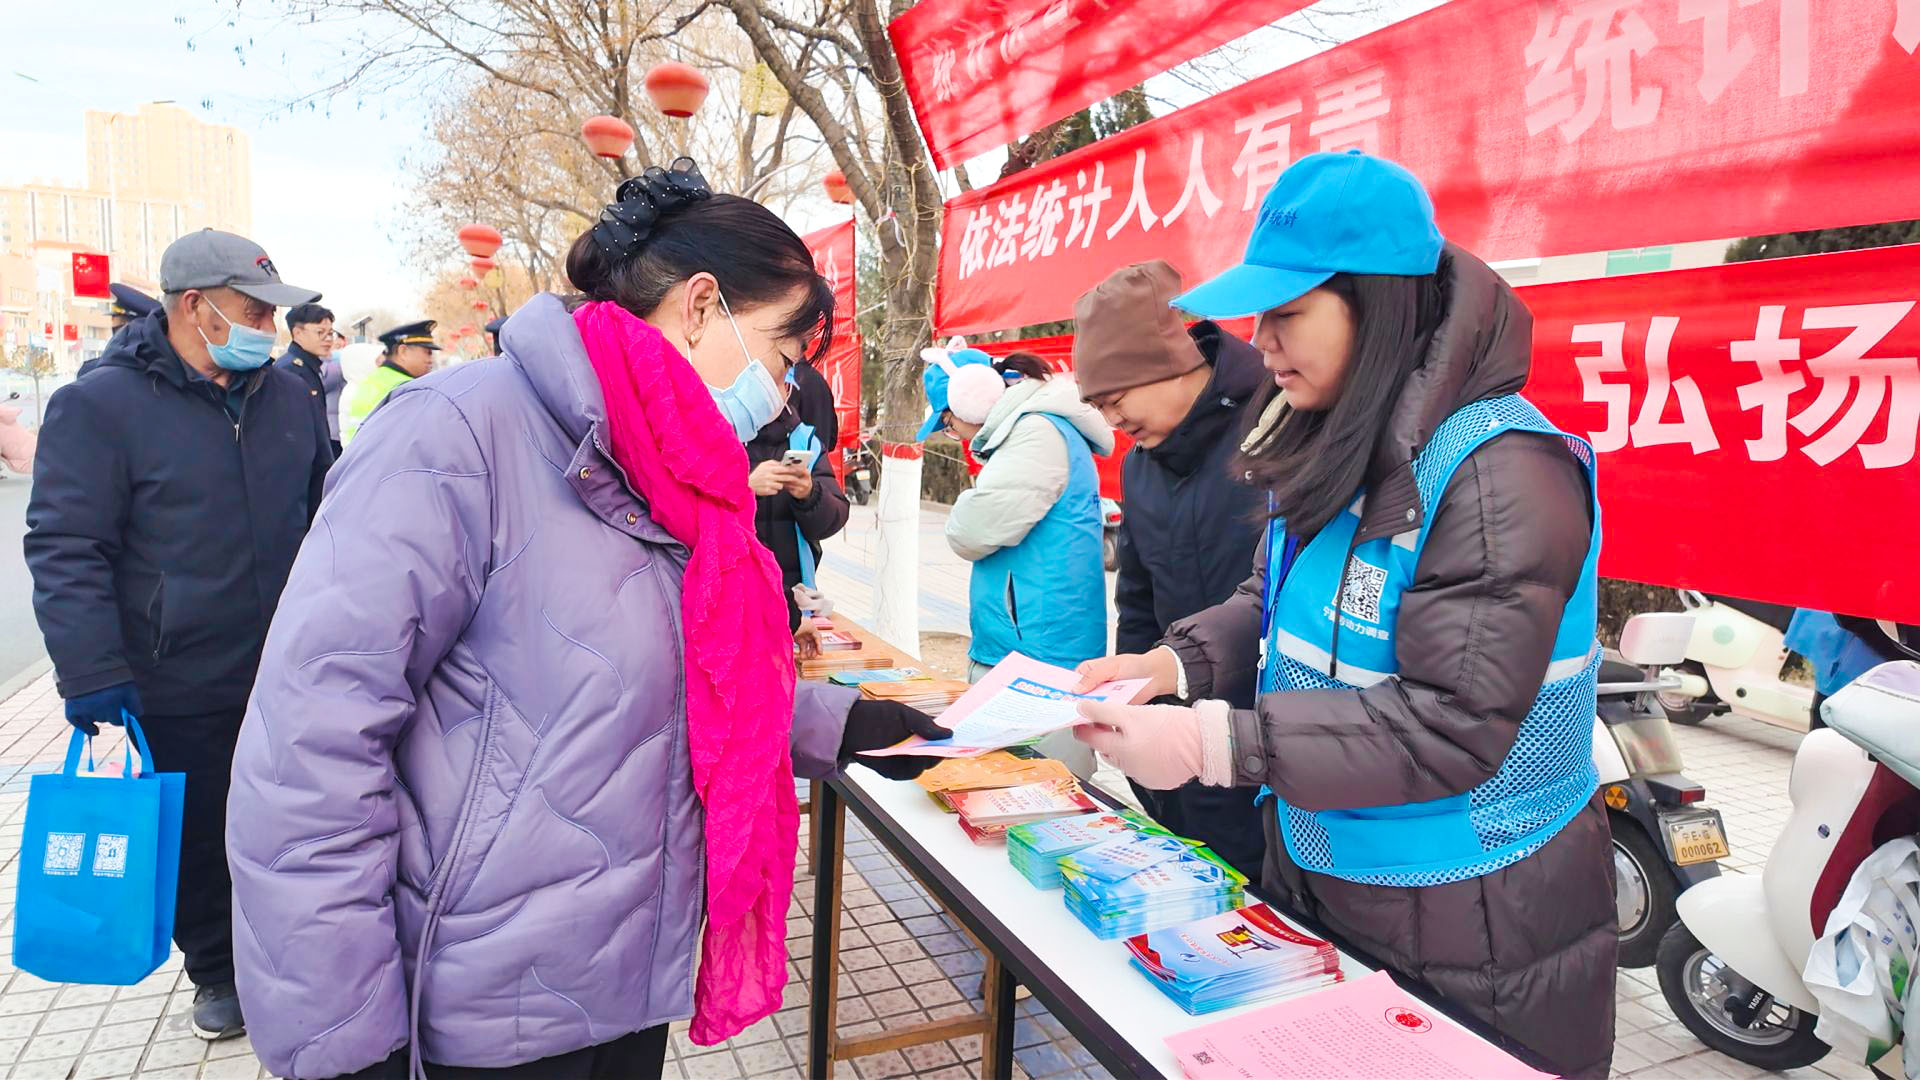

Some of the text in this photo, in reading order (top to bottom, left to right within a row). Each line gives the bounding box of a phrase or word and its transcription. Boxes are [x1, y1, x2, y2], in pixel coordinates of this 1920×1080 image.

[958, 0, 1920, 280] 依法统计人人有责 统计
[1570, 301, 1920, 470] 弘扬
[1681, 842, 1721, 858] 000062
[1747, 991, 1765, 1010] YADEA
